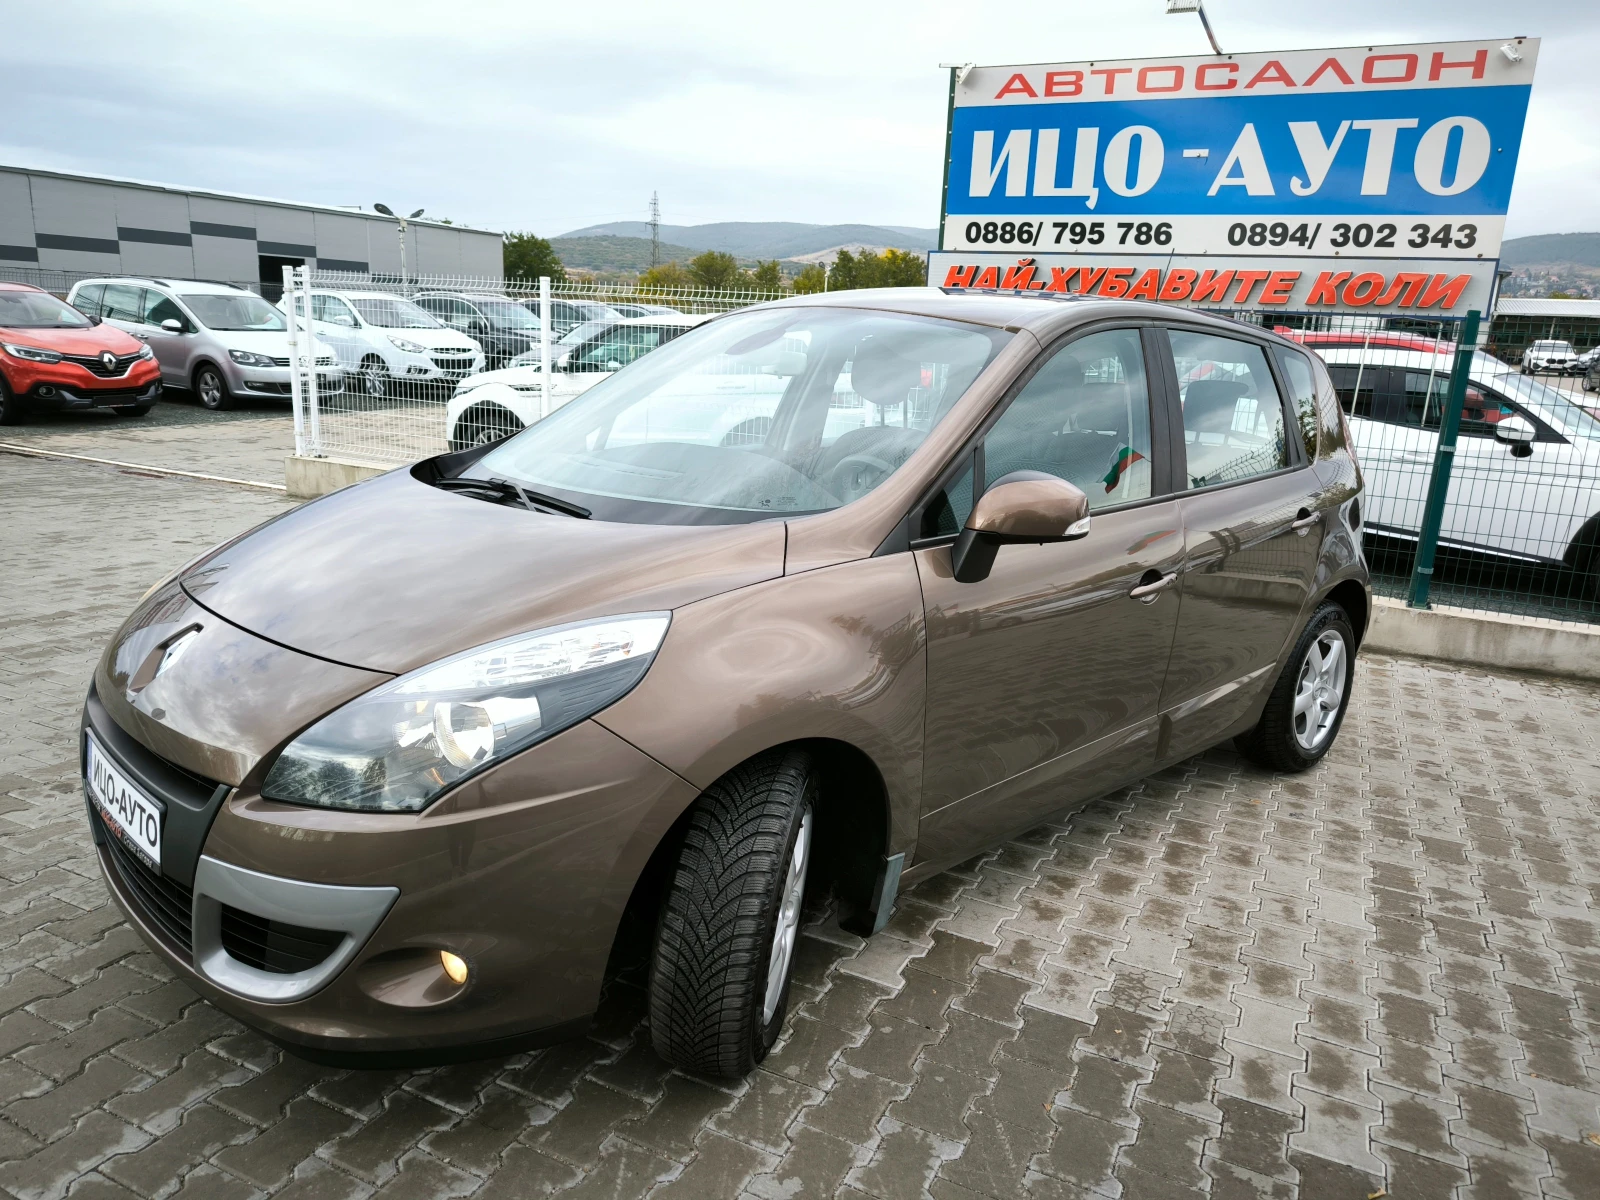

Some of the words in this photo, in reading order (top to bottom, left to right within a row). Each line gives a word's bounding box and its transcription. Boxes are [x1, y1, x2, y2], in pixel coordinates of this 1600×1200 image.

[994, 50, 1488, 99] АВТОСАЛОН
[965, 222, 1043, 246] 0886/
[1052, 222, 1105, 245] 795
[1117, 222, 1173, 246] 786
[1227, 222, 1322, 249] 0894/
[1330, 223, 1397, 248] 302
[1407, 223, 1478, 249] 343
[943, 258, 1302, 304] НАЙ-ХУБАВИТЕ
[1305, 271, 1472, 309] КОЛИ
[94, 754, 158, 848] ИЦО-АУТО
